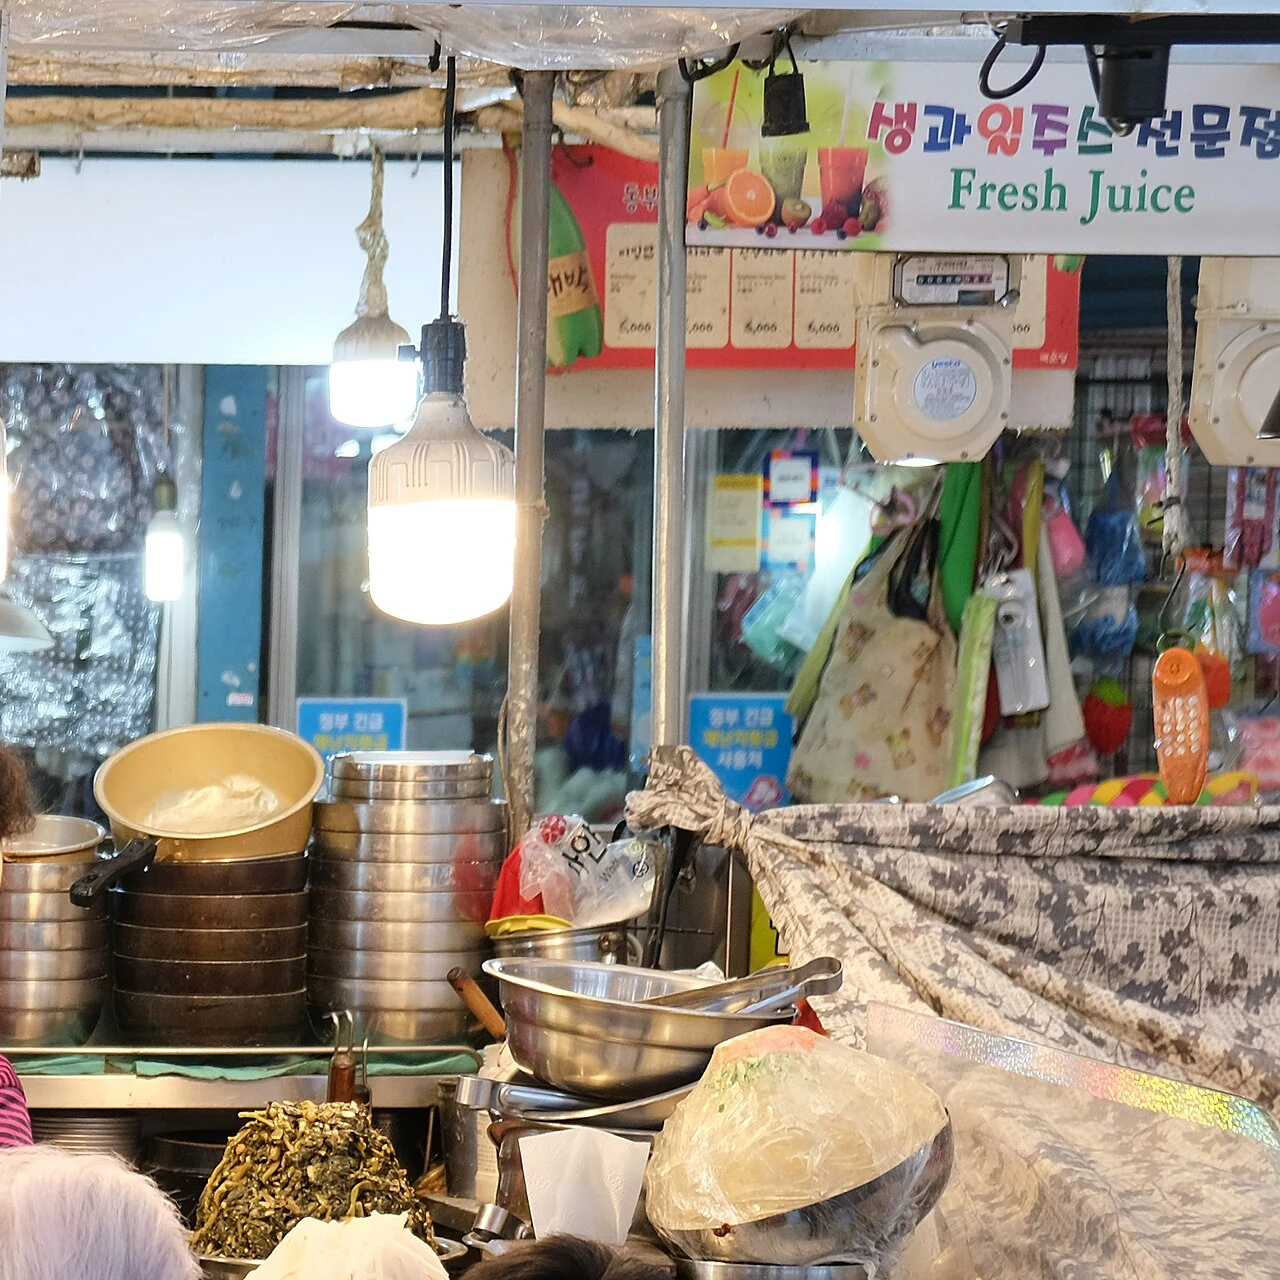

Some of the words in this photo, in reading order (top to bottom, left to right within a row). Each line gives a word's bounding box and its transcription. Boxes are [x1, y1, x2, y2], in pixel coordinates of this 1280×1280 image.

[867, 101, 1114, 156] 생과일주스
[947, 166, 1068, 213] Fresh
[1079, 167, 1196, 226] Juice
